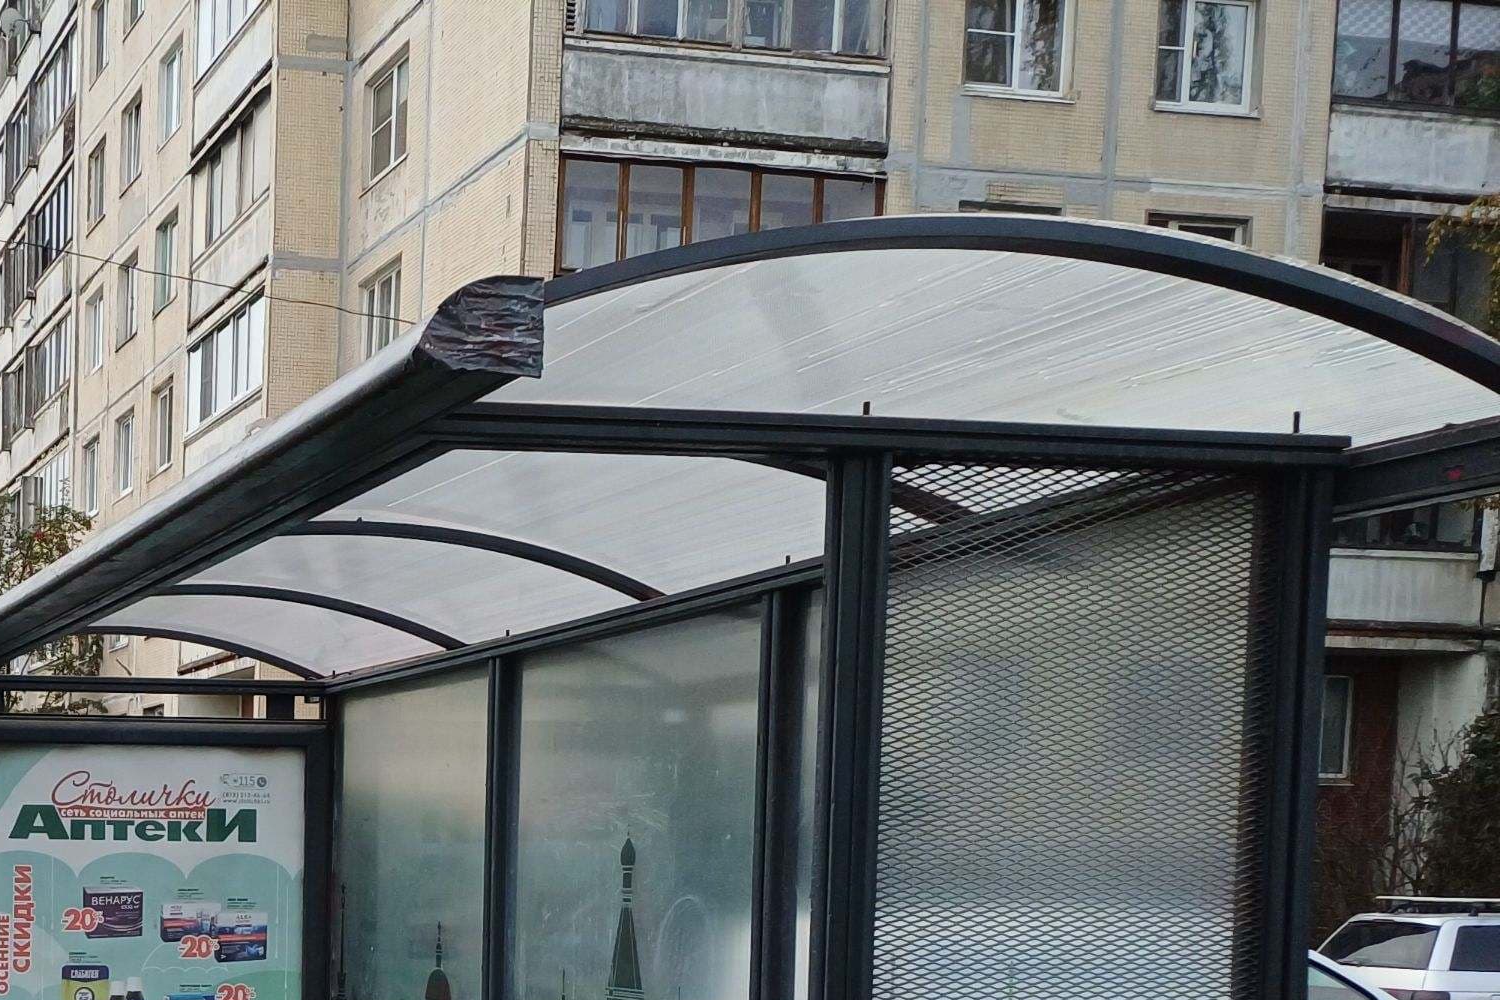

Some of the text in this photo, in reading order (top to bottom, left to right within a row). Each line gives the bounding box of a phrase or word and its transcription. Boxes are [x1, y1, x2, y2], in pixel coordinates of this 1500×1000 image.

[51, 770, 217, 807] Столички
[60, 808, 206, 820] сеть социальных аптек
[91, 895, 141, 906] ВЕНАРУС
[13, 865, 35, 973] СКИДКИ
